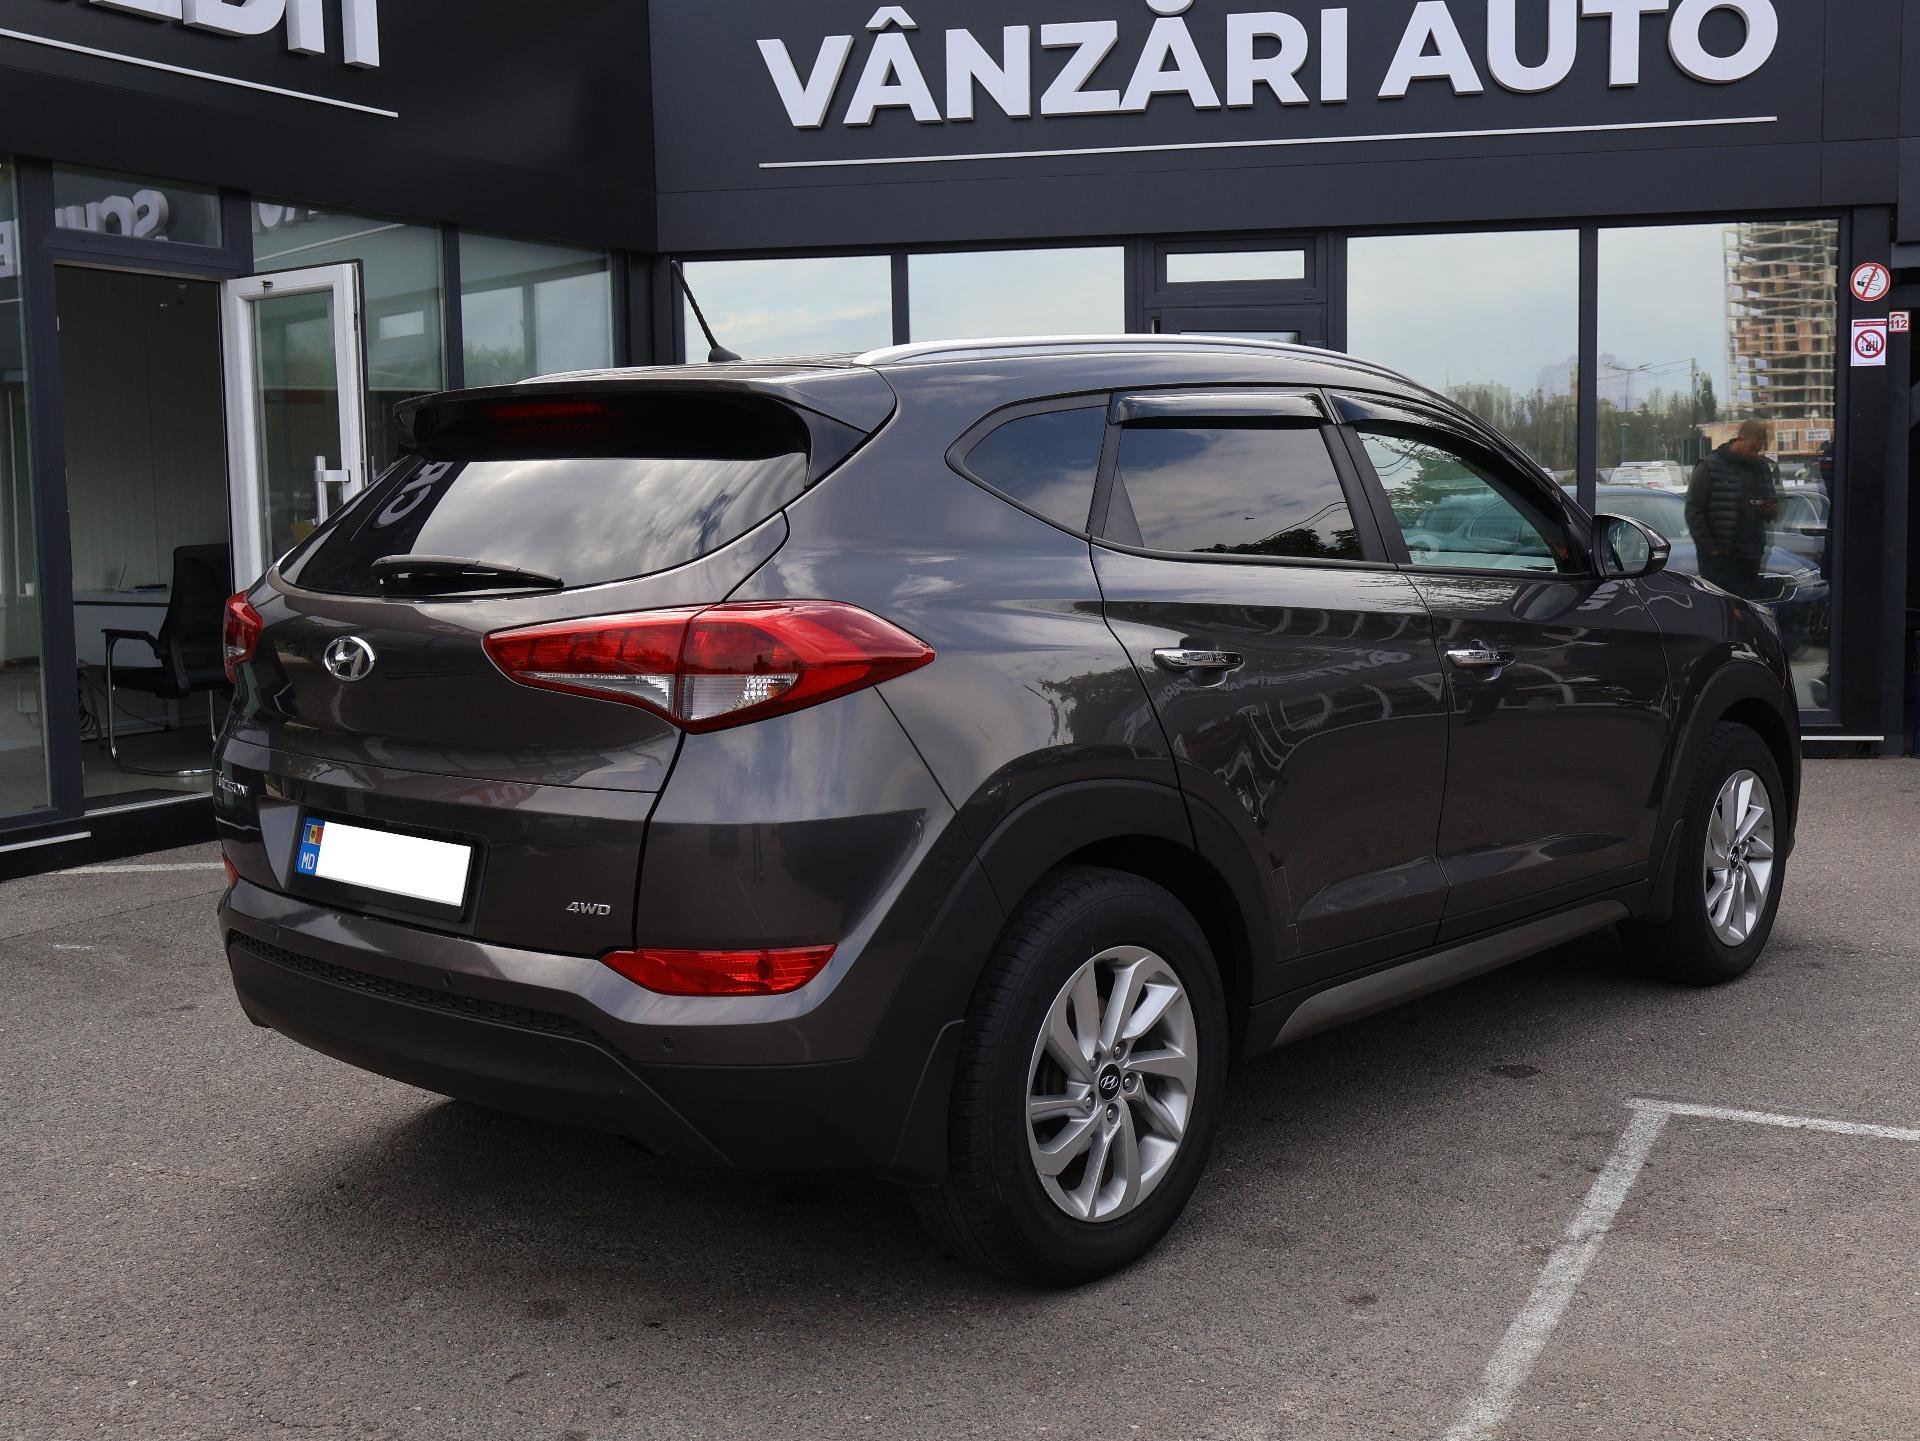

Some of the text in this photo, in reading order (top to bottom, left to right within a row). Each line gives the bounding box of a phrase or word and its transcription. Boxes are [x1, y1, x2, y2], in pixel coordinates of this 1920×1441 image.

[1377, 0, 1779, 99] AUTO
[1890, 319, 1907, 328] 112
[300, 851, 316, 870] MD
[565, 901, 611, 916] 4WD
